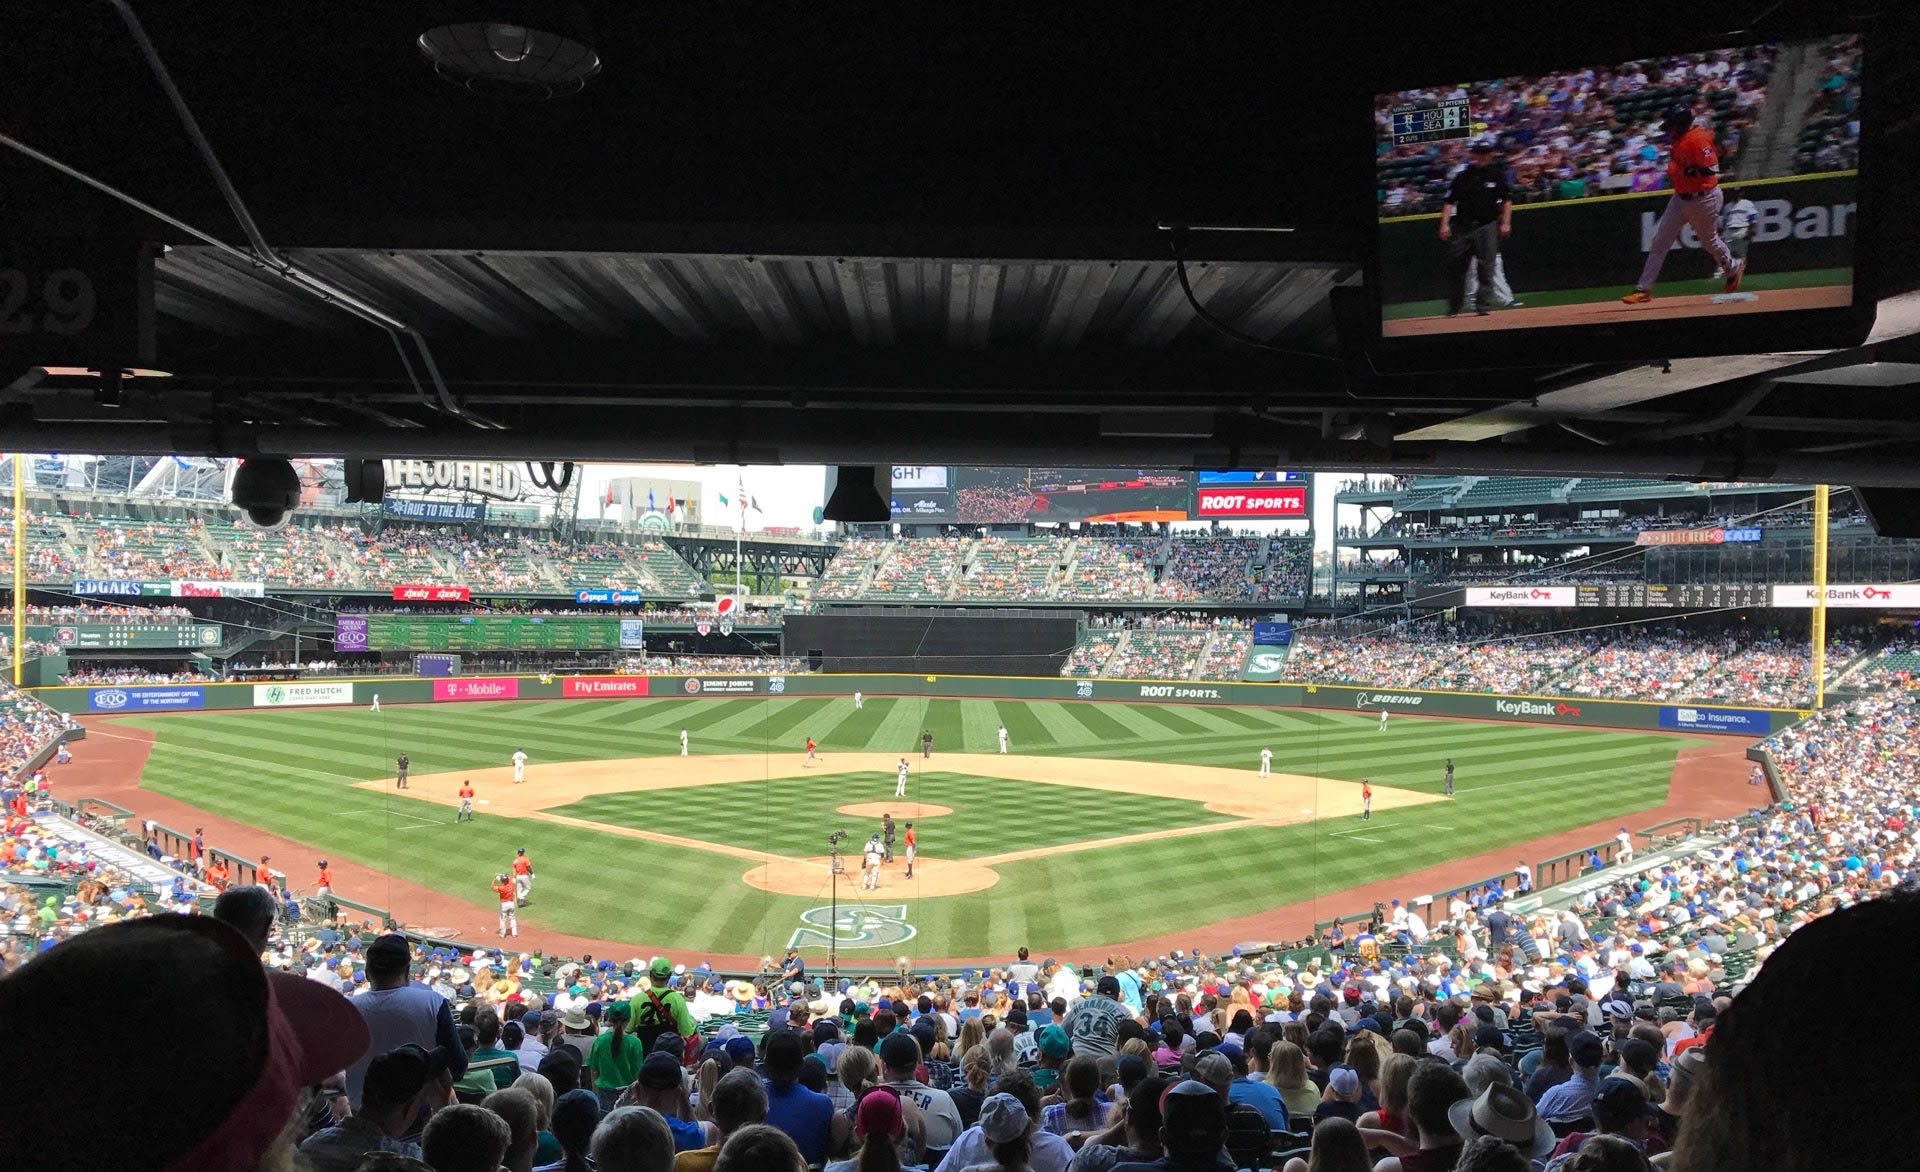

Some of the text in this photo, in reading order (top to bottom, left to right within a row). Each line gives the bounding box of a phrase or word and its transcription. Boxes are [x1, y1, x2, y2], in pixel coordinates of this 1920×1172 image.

[1423, 110, 1443, 120] HOU
[1448, 108, 1455, 116] 4
[1423, 119, 1455, 130] SEA 2
[455, 461, 521, 500] FIELD
[1201, 495, 1301, 510] ROOT SPORTS
[403, 501, 477, 518] TRUE TO THE BLUE
[74, 580, 142, 596] EDGARS
[180, 583, 222, 597] Coors
[403, 588, 430, 600] xfinity
[436, 589, 462, 600] xfinity
[1490, 590, 1529, 601] KeyBank
[622, 622, 640, 631] BUILT
[575, 681, 638, 694] Fly Emirates
[703, 680, 754, 688] JIMMY JOHN'S
[289, 687, 312, 695] FRED
[1076, 686, 1093, 697] 40
[1140, 685, 1218, 699] ROOT SPORTS
[95, 693, 127, 705] EQC
[1371, 694, 1423, 705] BOEING
[1496, 700, 1556, 716] KeyBank
[1679, 710, 1746, 724] Safeco Insurance
[1072, 998, 1126, 1023] HERNANDEZ
[1078, 1012, 1109, 1037] 34
